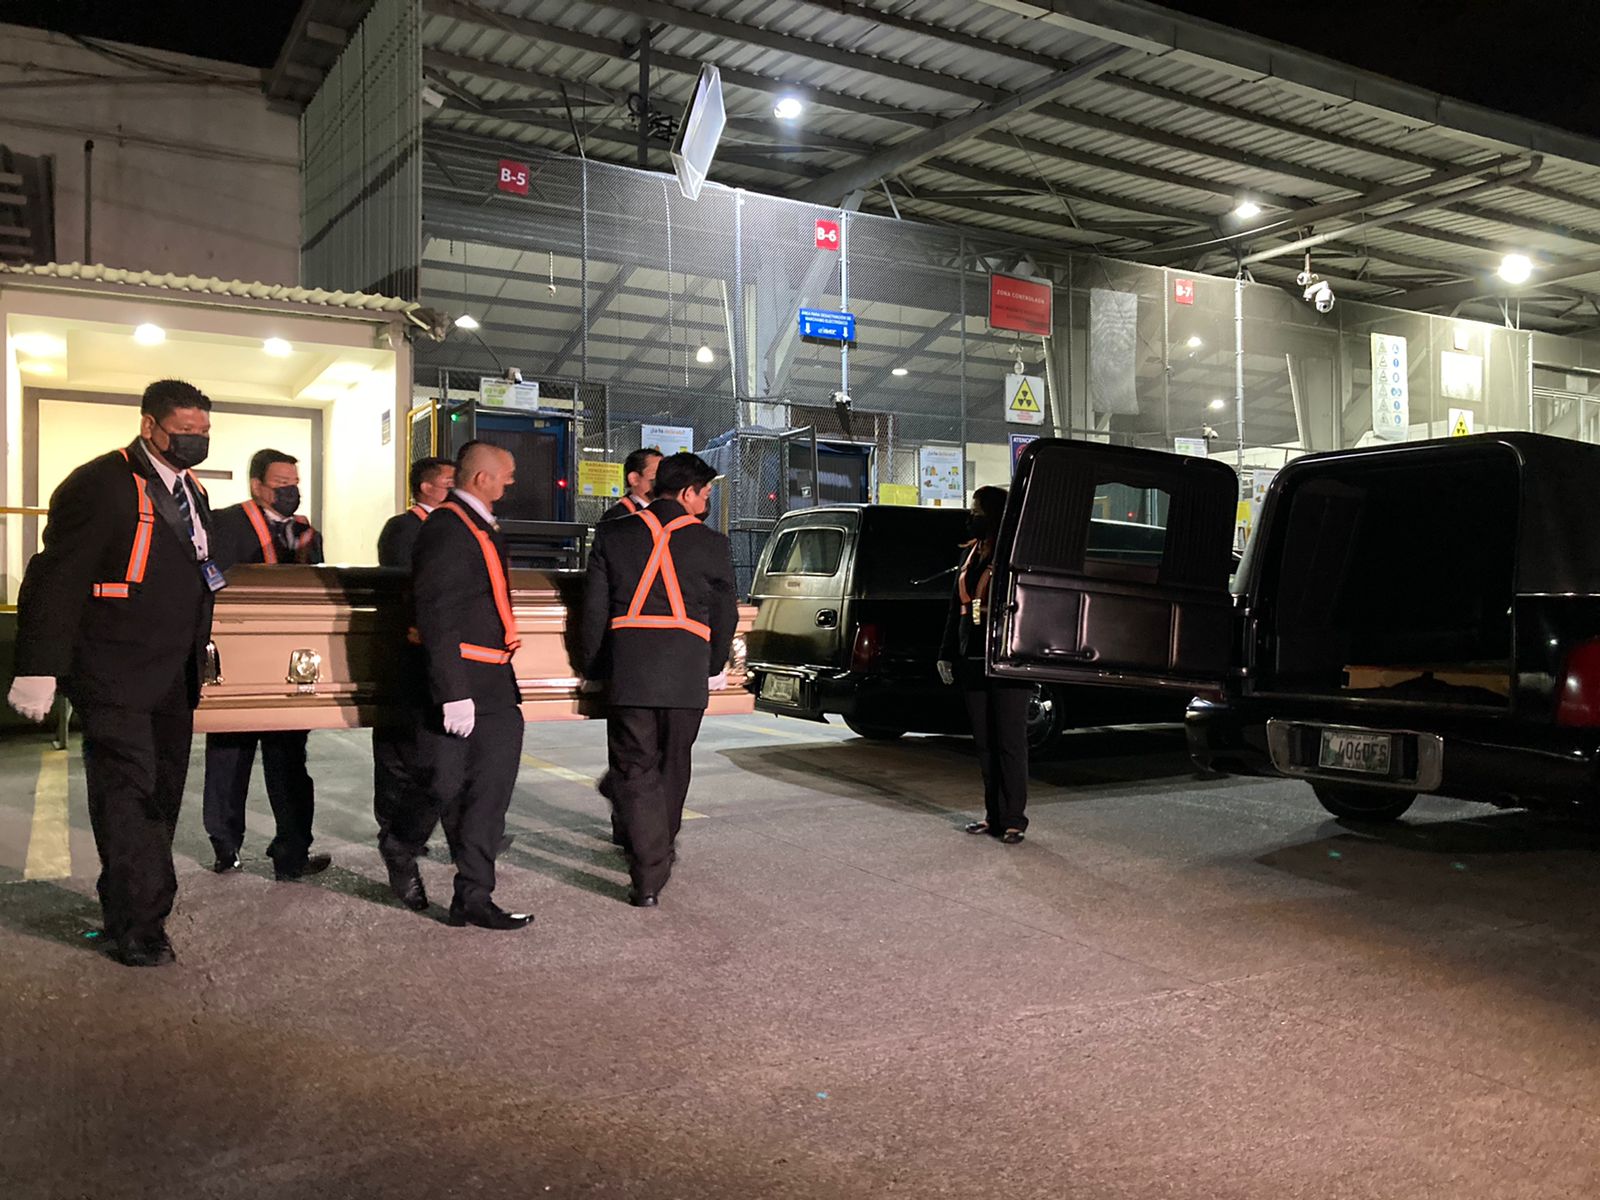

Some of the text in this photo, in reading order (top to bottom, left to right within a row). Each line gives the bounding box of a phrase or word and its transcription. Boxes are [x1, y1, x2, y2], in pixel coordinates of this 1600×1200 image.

[501, 168, 526, 186] B-5
[817, 227, 837, 242] B-6
[996, 289, 1011, 297] ZONA
[1176, 285, 1191, 297] B-7
